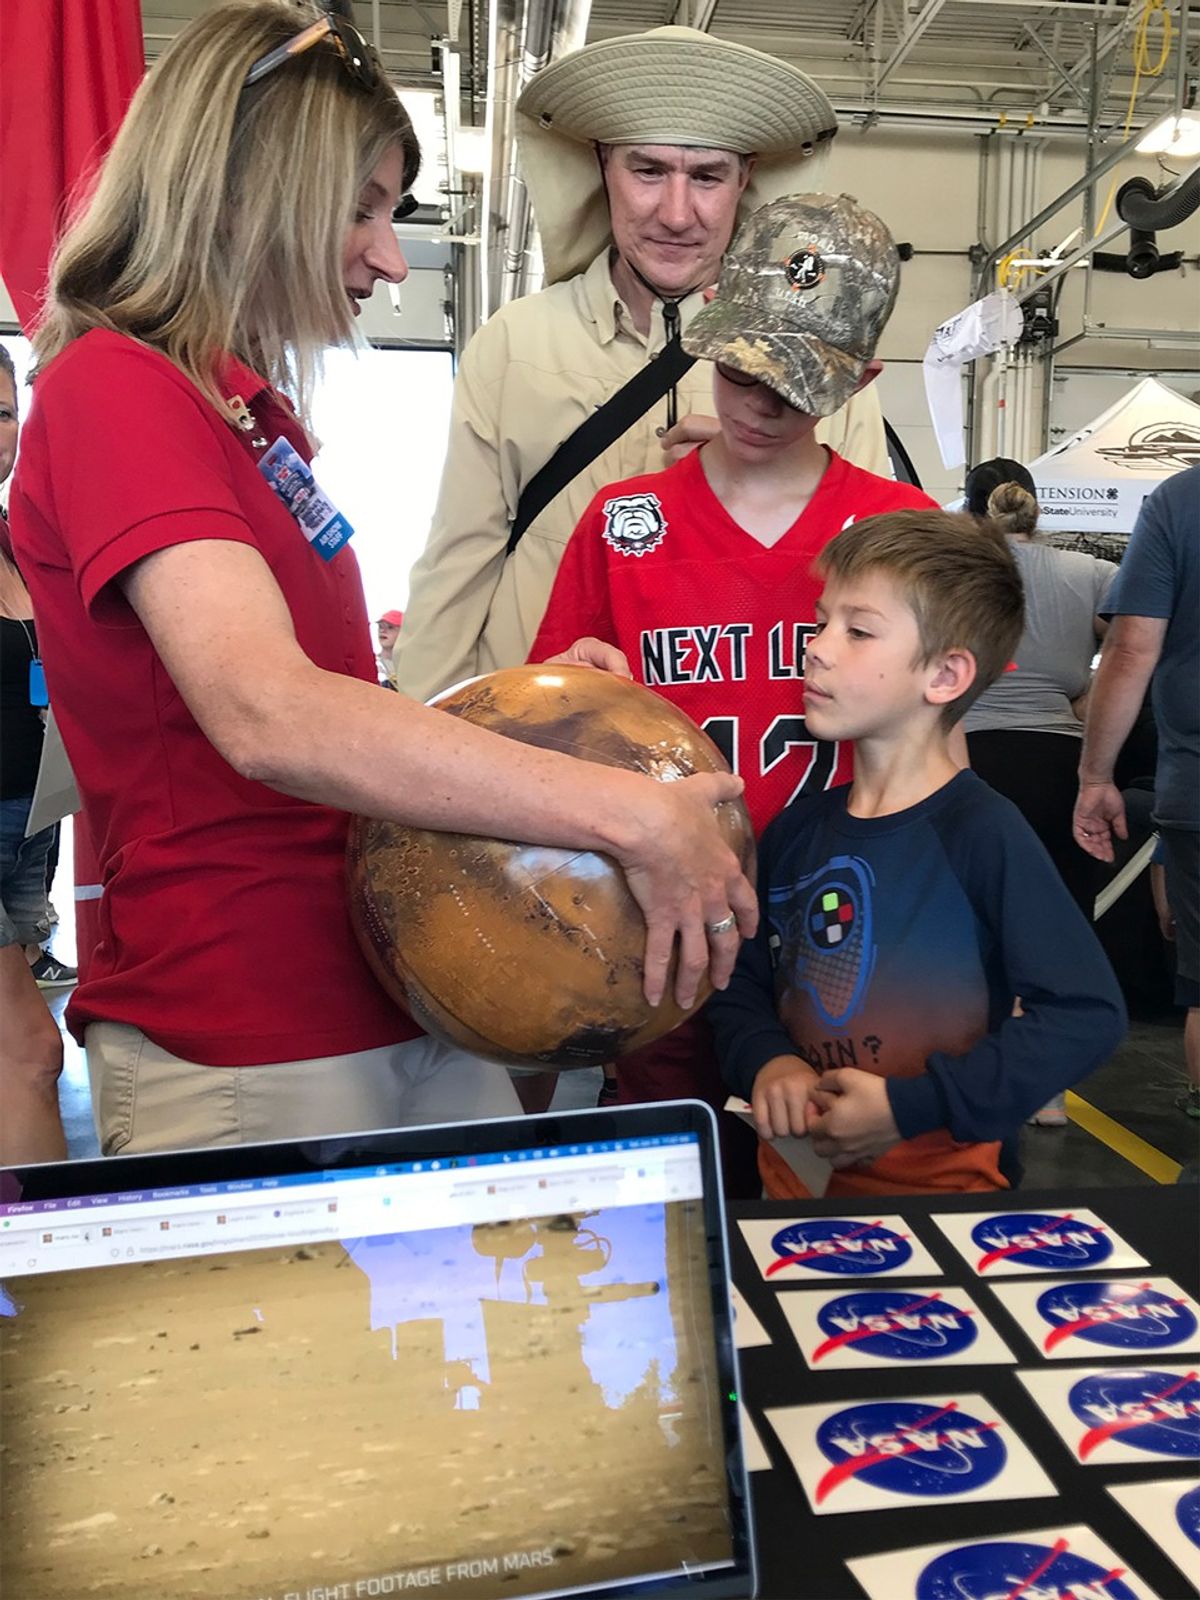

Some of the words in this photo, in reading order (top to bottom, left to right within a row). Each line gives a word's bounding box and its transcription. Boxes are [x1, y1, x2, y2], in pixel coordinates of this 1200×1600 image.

[1036, 487, 1106, 500] TENSION
[640, 623, 753, 686] NEXT
[768, 620, 818, 680] LE
[8, 1204, 34, 1214] Firefox
[67, 1199, 81, 1208] Edit
[91, 1197, 109, 1205] View
[118, 1193, 143, 1202] History
[153, 1188, 189, 1199] Bookmarks
[199, 1185, 217, 1194] Tools
[227, 1181, 253, 1191] Window
[262, 1179, 279, 1188] Help
[781, 1236, 898, 1255] NASA
[983, 1231, 1099, 1250] NASA
[1050, 1302, 1180, 1323] NASA
[829, 1313, 962, 1334] NASA
[829, 1428, 988, 1457] NASA
[356, 1568, 441, 1598] FOOTAGE
[446, 1558, 498, 1581] FROM
[503, 1549, 554, 1571] MARS
